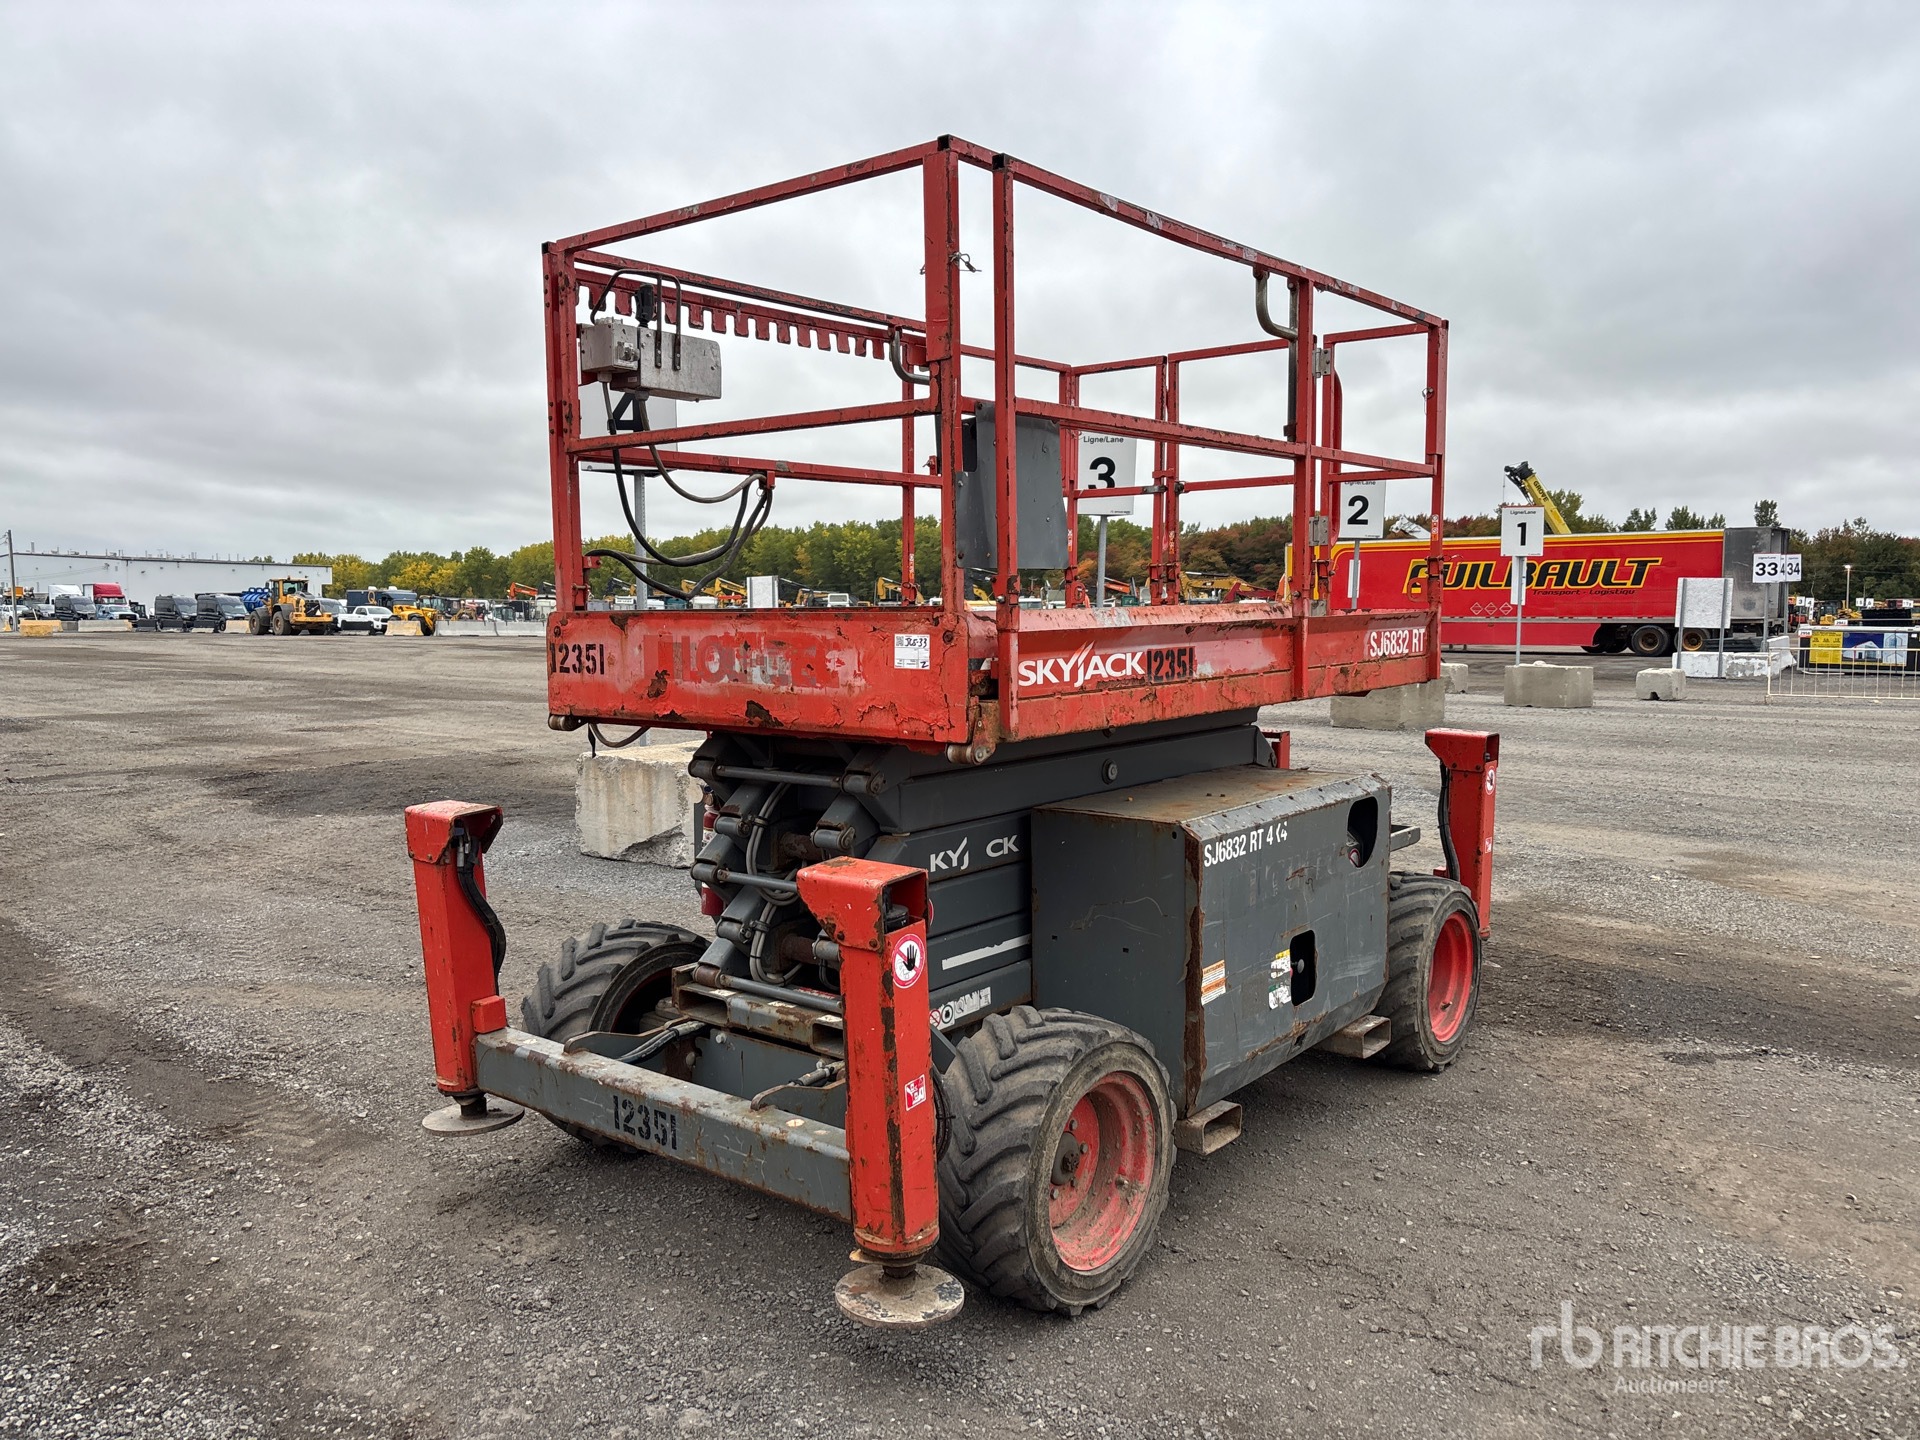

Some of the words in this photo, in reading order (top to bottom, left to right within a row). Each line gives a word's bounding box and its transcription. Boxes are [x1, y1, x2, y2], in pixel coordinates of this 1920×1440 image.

[1083, 436, 1124, 445] Ligne/Lane
[1088, 456, 1116, 490] 3
[1533, 480, 1549, 503] GROVE
[1347, 494, 1369, 525] 2
[1517, 522, 1527, 546] 1
[1755, 562, 1778, 576] 33
[1787, 562, 1800, 575] 34
[1533, 588, 1580, 596] Transport
[1369, 629, 1409, 657] SJ6832
[1412, 628, 1426, 653] RT
[550, 642, 605, 675] 12351
[1018, 640, 1146, 688] SKYJACK
[1146, 647, 1195, 682] 12351
[1203, 834, 1247, 867] SJ6832
[1249, 828, 1264, 853] RT
[612, 1094, 678, 1151] 12351
